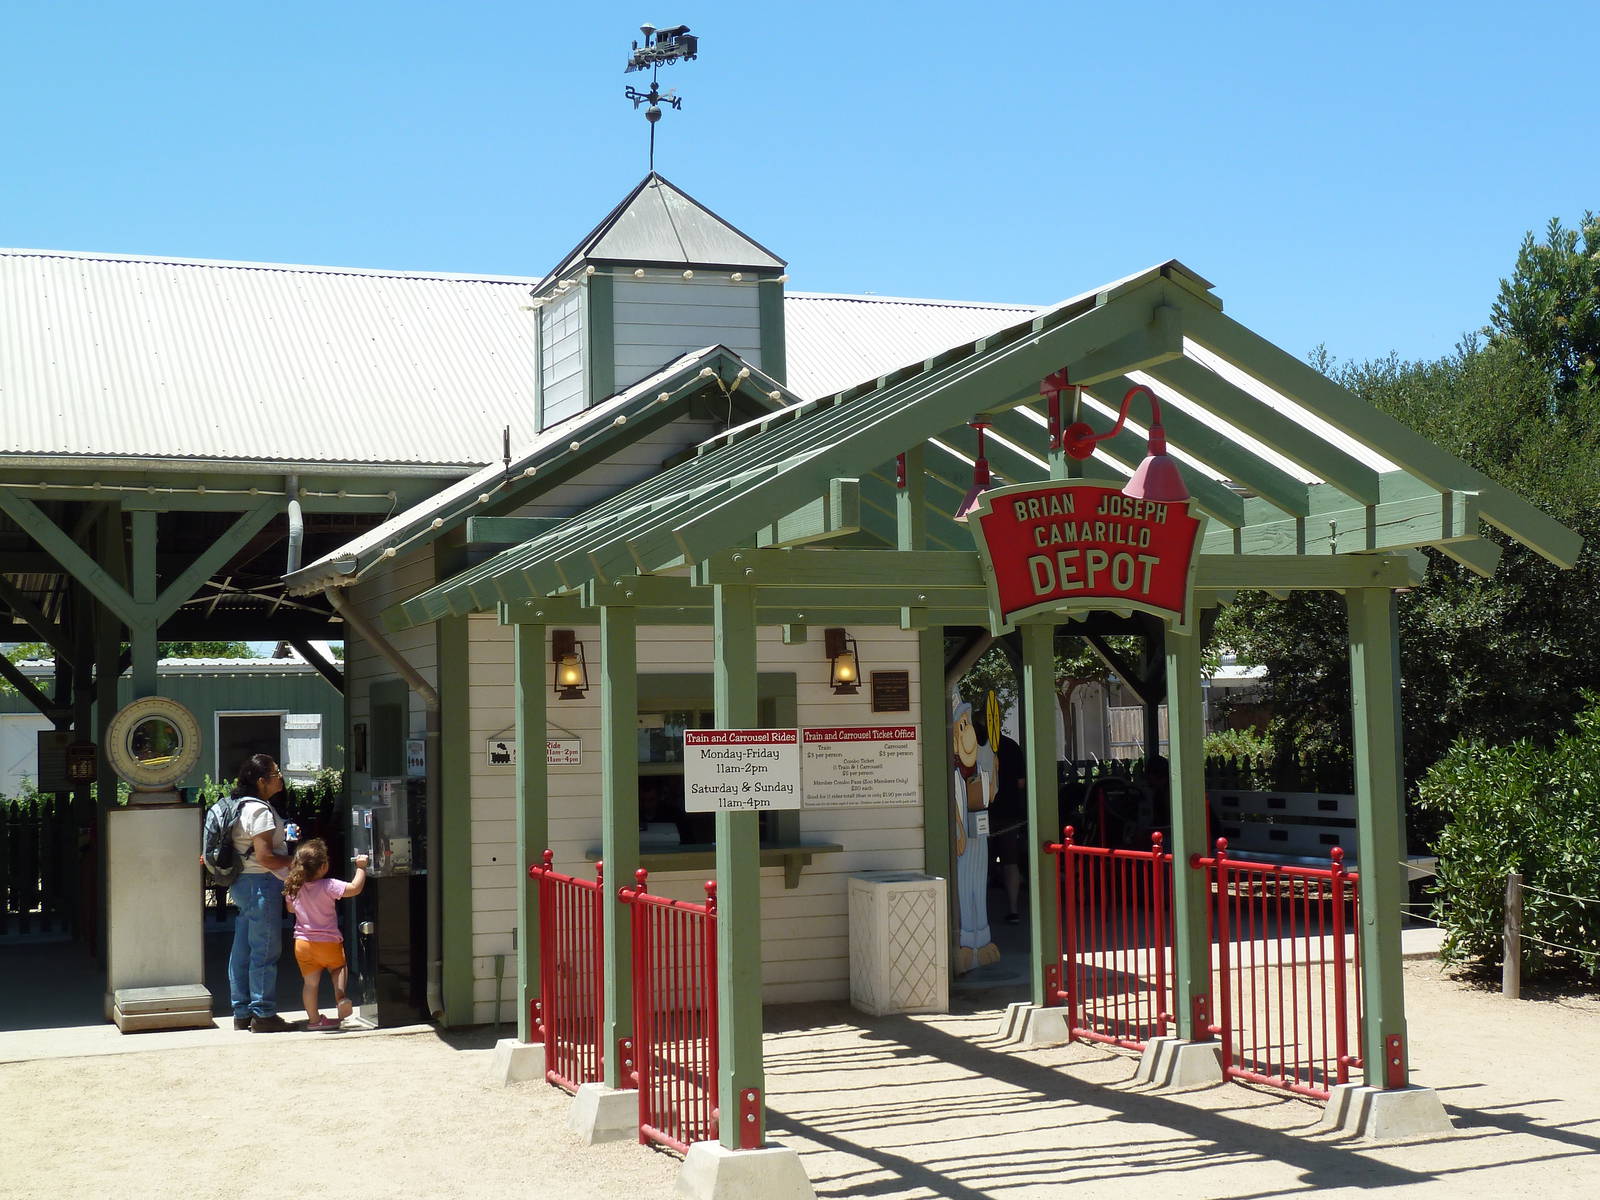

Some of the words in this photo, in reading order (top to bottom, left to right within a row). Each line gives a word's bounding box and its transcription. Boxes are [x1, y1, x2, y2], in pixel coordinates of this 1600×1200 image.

[1014, 493, 1075, 522] BRIAN
[1098, 495, 1168, 524] JOSEPH
[1034, 521, 1151, 548] CAMARILLO
[1027, 549, 1160, 596] DEPOT
[686, 734, 709, 743] Train
[712, 733, 726, 742] and
[729, 732, 770, 742] Carrousel
[772, 732, 796, 742] Rides
[804, 732, 823, 740] Train
[824, 731, 837, 740] and
[838, 730, 871, 740] Carrousel
[872, 730, 893, 739] Ticket
[894, 729, 914, 738] Office
[700, 748, 780, 760] Monday-Friday
[717, 763, 768, 775] 11am-2pm
[692, 783, 738, 795] Saturday
[742, 782, 751, 792] &
[754, 782, 794, 794] Sunday
[719, 798, 770, 809] 11am-4pm
